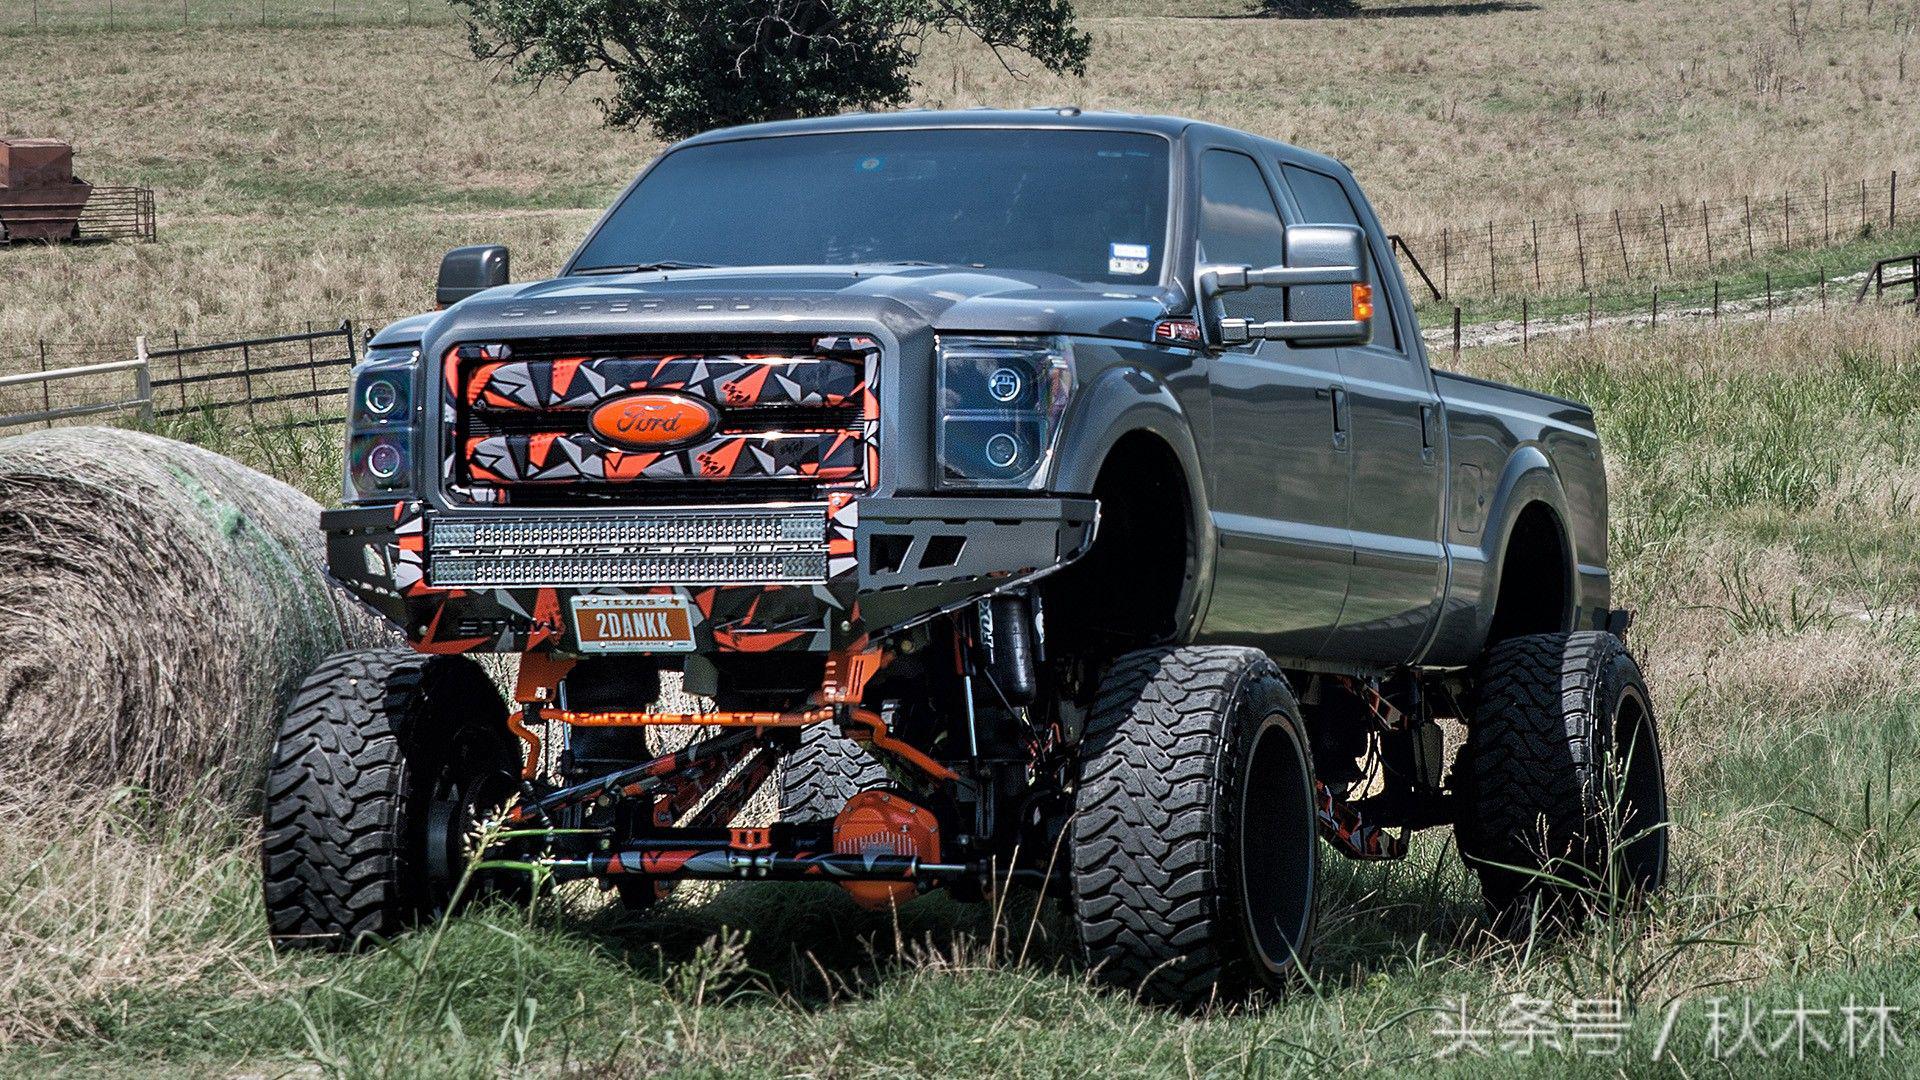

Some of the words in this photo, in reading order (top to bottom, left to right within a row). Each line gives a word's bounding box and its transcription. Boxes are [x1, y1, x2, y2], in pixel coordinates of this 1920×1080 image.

[616, 405, 683, 433] Ford
[602, 598, 656, 607] TEXAS
[595, 612, 672, 639] 2DANKK
